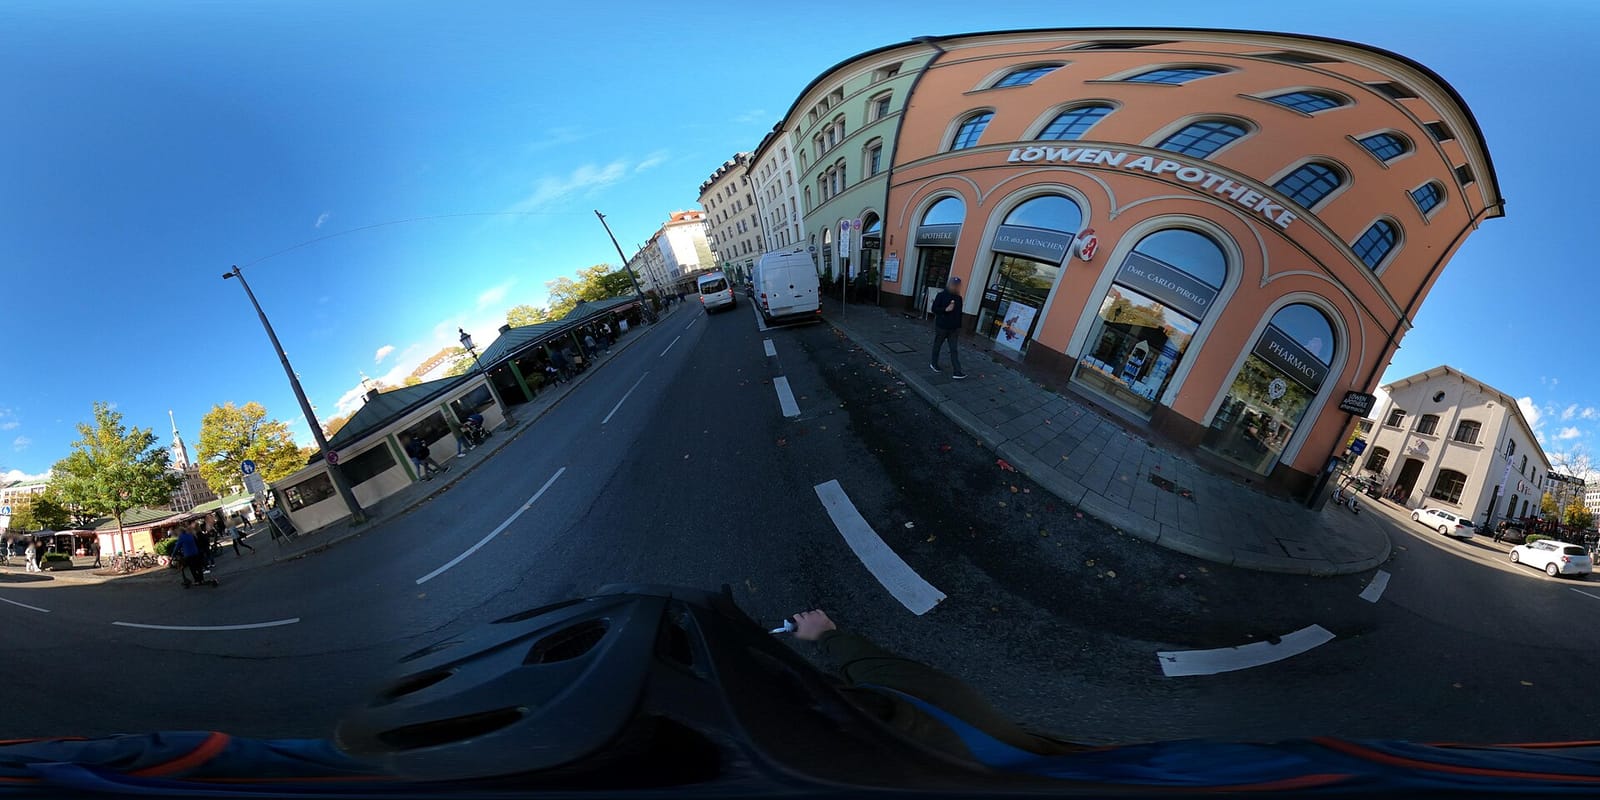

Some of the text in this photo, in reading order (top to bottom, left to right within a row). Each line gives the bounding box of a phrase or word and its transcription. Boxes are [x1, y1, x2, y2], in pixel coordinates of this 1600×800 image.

[1007, 146, 1298, 230] LÖWEN APOTHEKE
[1025, 237, 1064, 250] MÜNCHEN
[1147, 273, 1176, 290] CARLO
[1175, 286, 1206, 305] PIROLO
[1268, 340, 1318, 380] PHARMACY
